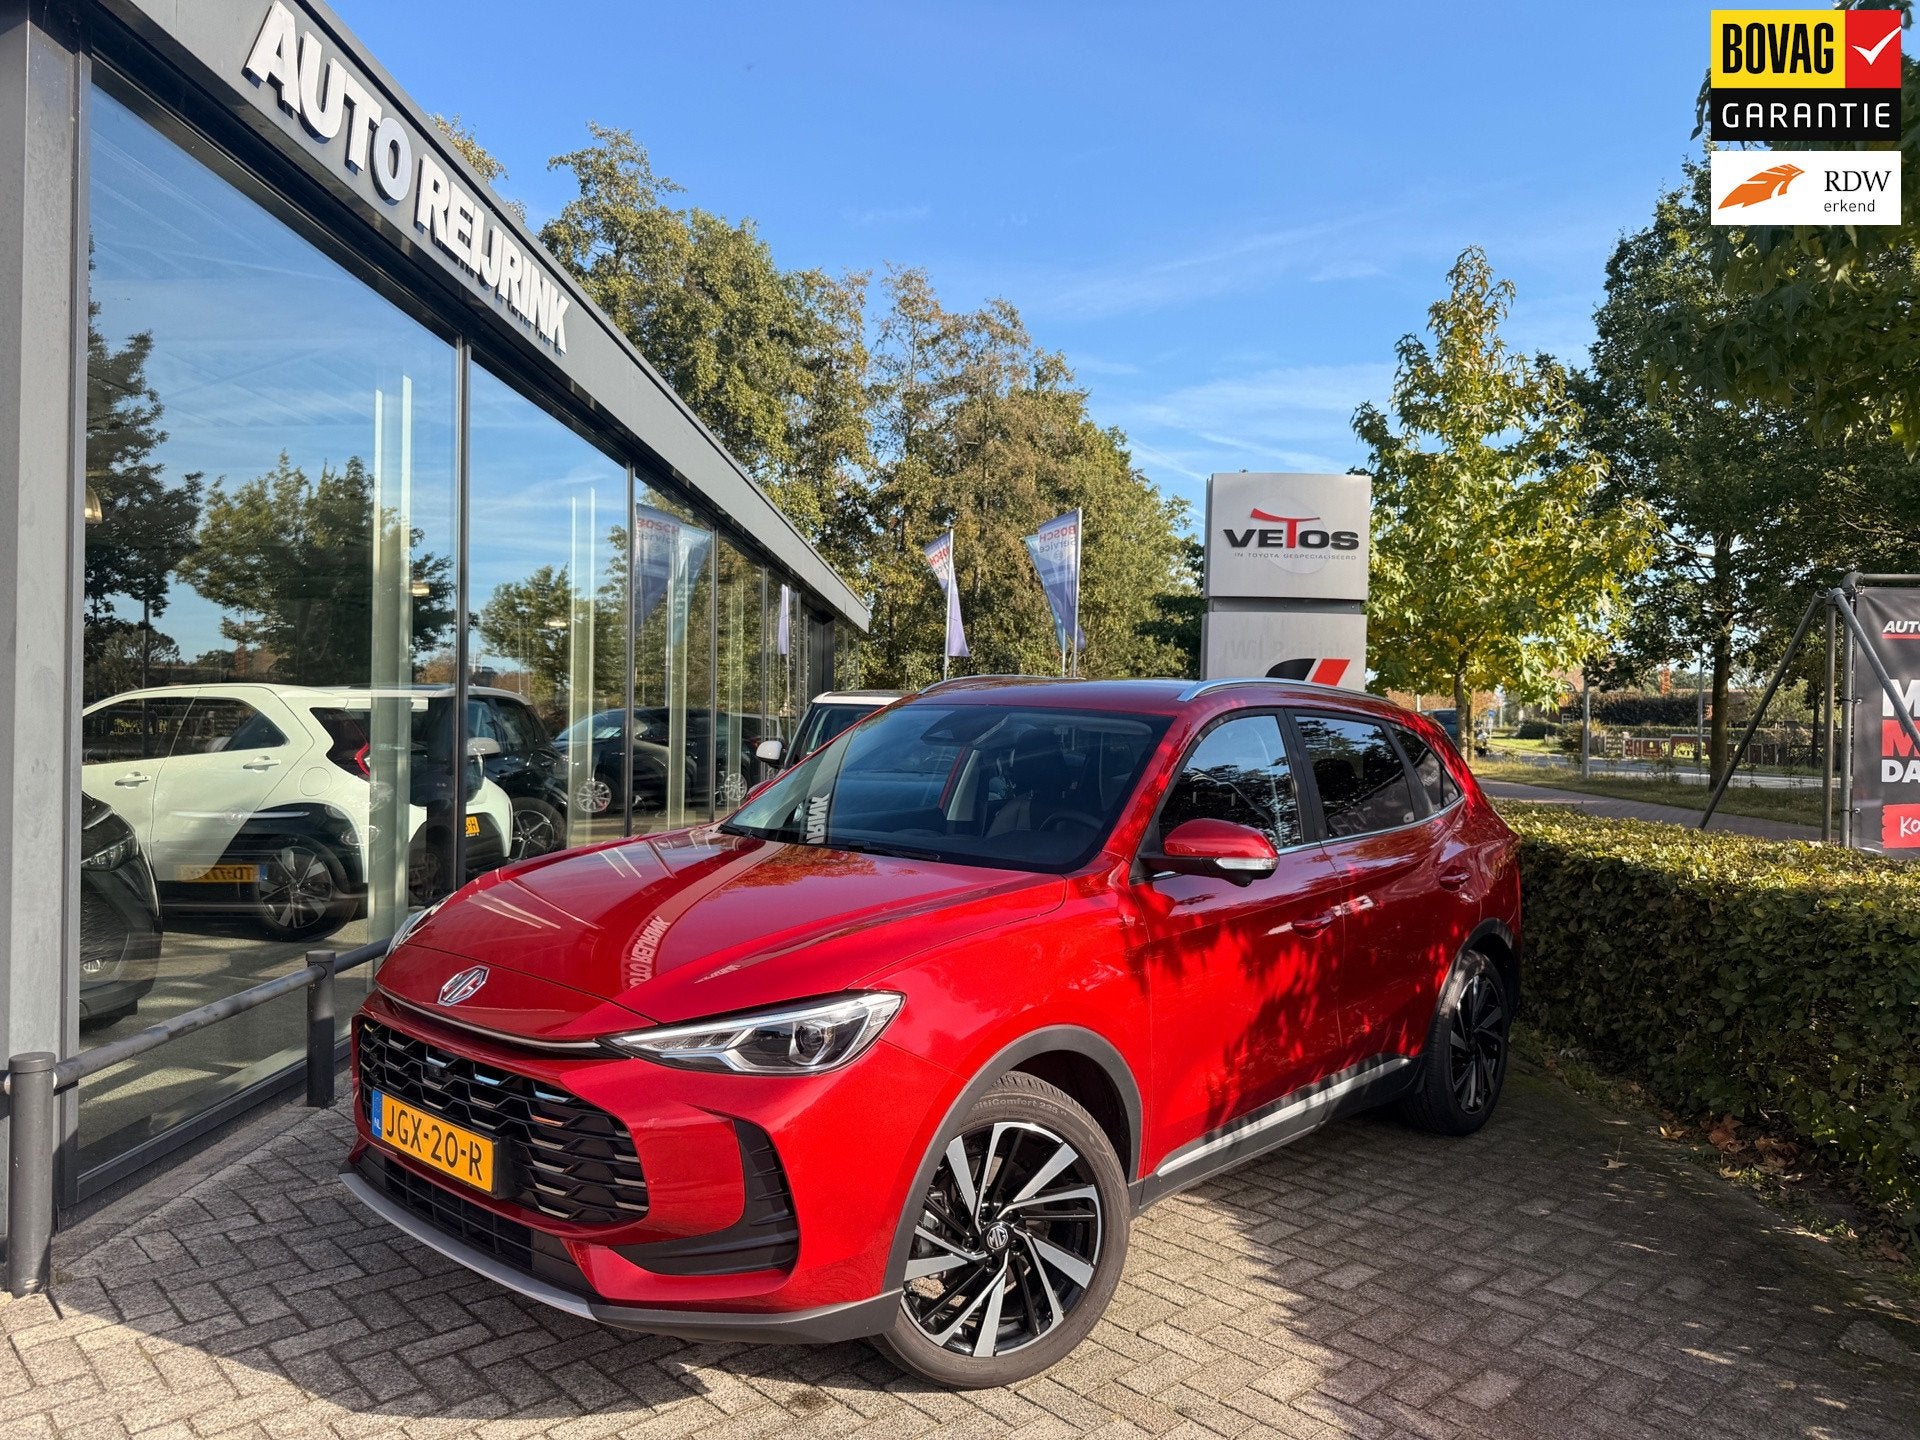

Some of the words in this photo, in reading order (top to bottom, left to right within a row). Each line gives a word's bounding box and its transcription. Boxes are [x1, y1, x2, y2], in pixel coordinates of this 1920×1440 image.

[245, 0, 412, 201] AUTO
[417, 154, 569, 354] REIJRINK
[1223, 508, 1360, 550] VETOS
[1882, 620, 1920, 633] AUT
[1881, 759, 1920, 783] DA
[386, 1105, 482, 1181] JGX-20-R
